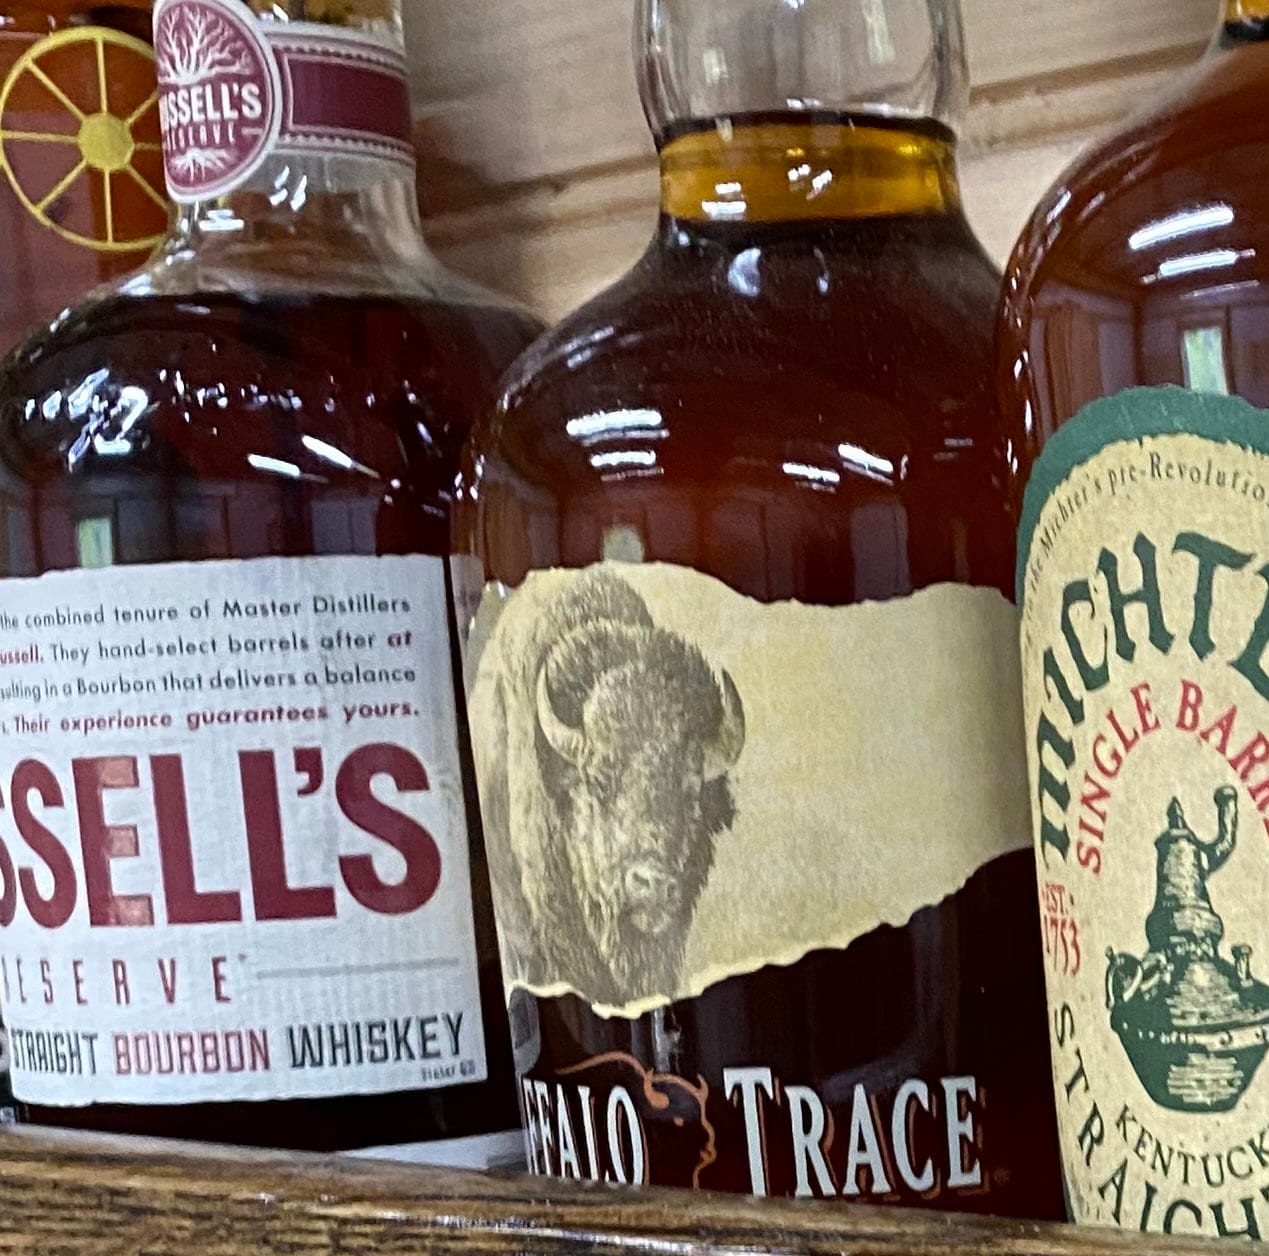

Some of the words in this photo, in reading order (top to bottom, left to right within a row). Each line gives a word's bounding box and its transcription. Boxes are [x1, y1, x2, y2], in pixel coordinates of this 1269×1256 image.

[1039, 470, 1103, 559] Michter's
[25, 603, 105, 630] combined
[114, 604, 179, 624] tenure
[190, 598, 210, 620] of
[223, 598, 301, 618] Master
[312, 593, 411, 615] Distillers
[50, 640, 90, 666] They
[98, 634, 217, 661] hand-select
[228, 631, 310, 653] barrels
[320, 628, 376, 651] after
[387, 629, 413, 648] at
[44, 677, 58, 699] in
[62, 681, 73, 698] a
[77, 672, 157, 697] Bourbon
[162, 669, 201, 693] that
[209, 668, 297, 690] delivers
[304, 671, 318, 688] a
[325, 663, 417, 685] balance
[13, 712, 51, 736] Their
[60, 708, 173, 737] experience
[186, 703, 329, 732] guarantees
[342, 701, 421, 724] yours.
[1077, 682, 1162, 876] SINGLE
[1043, 914, 1081, 977] 1753
[10, 1028, 98, 1076] STRAIGHT
[113, 1027, 270, 1075] BOURBON
[288, 1011, 464, 1069] WHISKEY
[723, 1066, 981, 1198] TRACE
